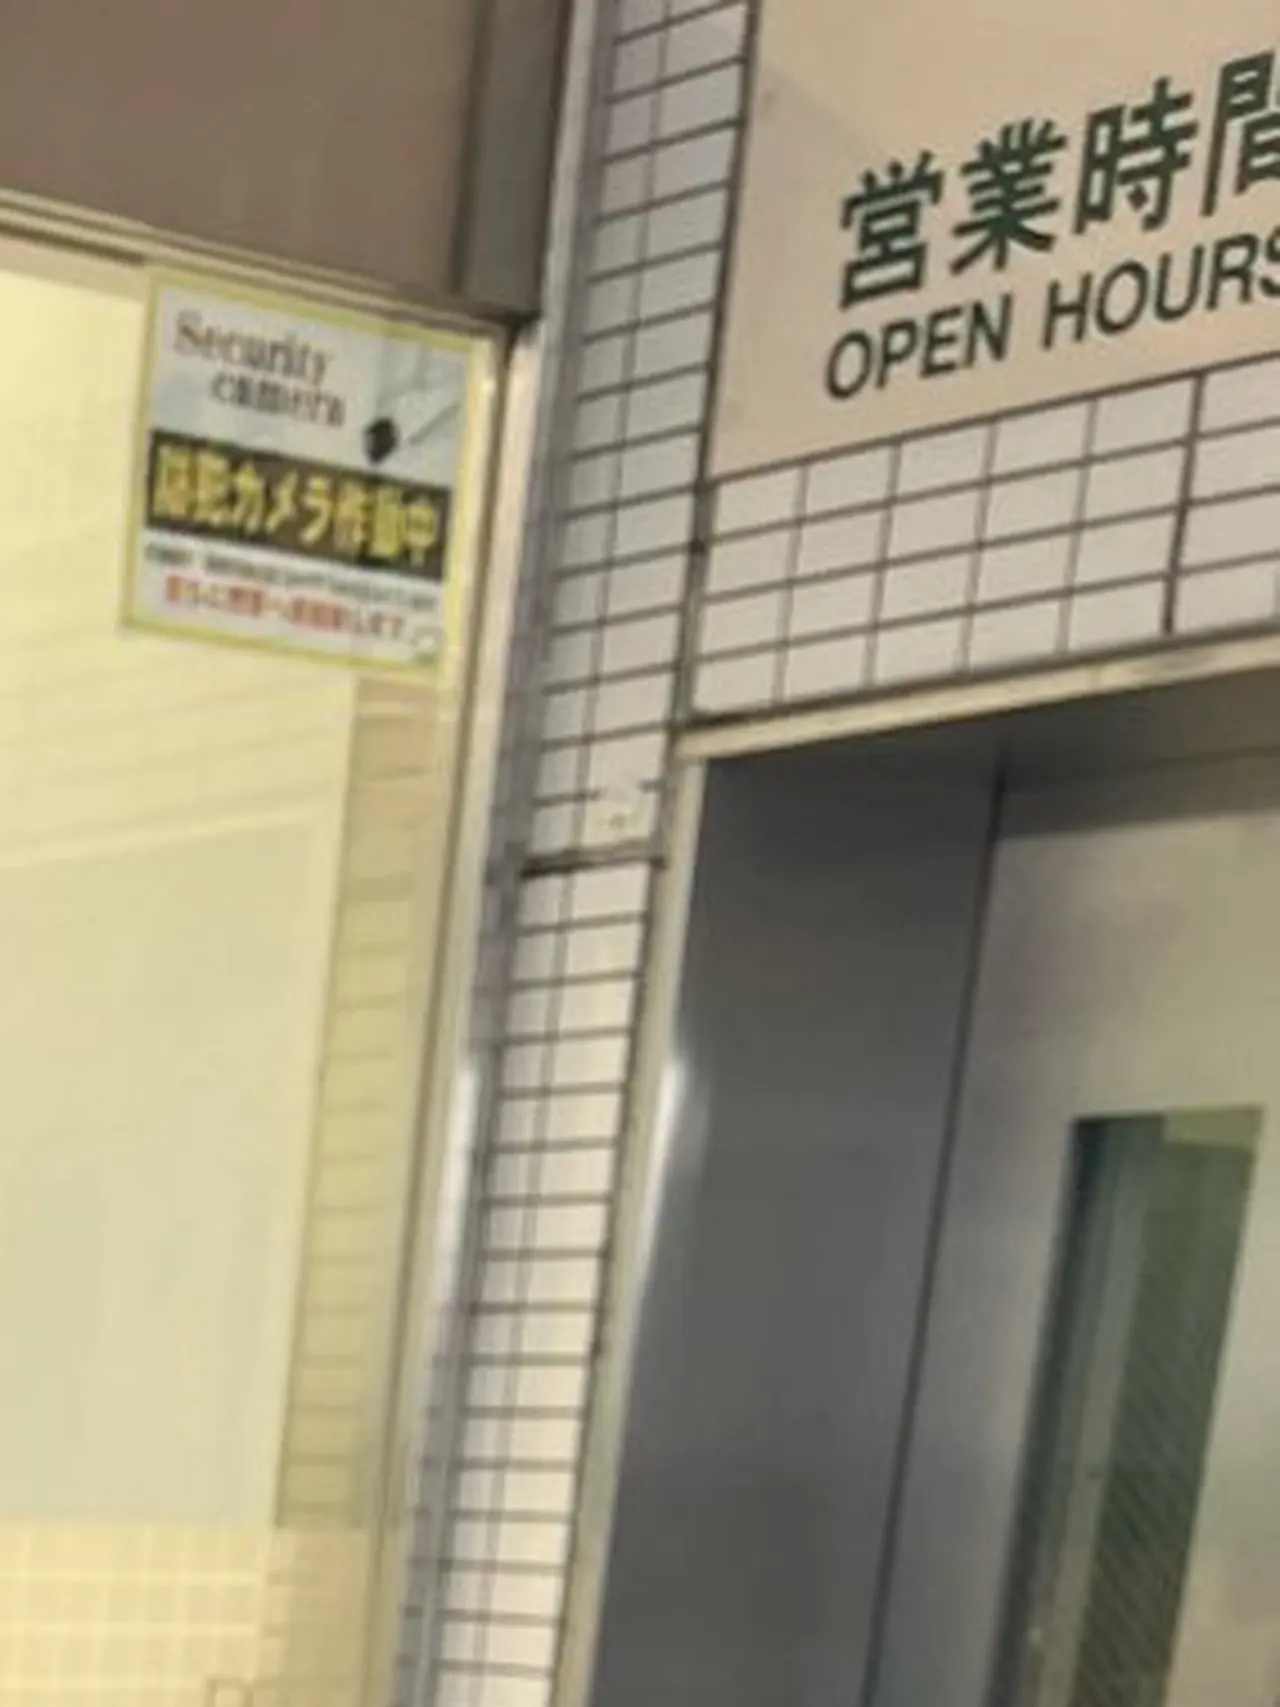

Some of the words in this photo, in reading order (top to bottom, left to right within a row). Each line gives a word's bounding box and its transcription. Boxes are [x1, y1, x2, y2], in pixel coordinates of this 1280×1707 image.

[840, 48, 1280, 312] 営業時間
[174, 310, 332, 387] Security
[825, 293, 1012, 400] OPEN
[210, 370, 348, 428] camera
